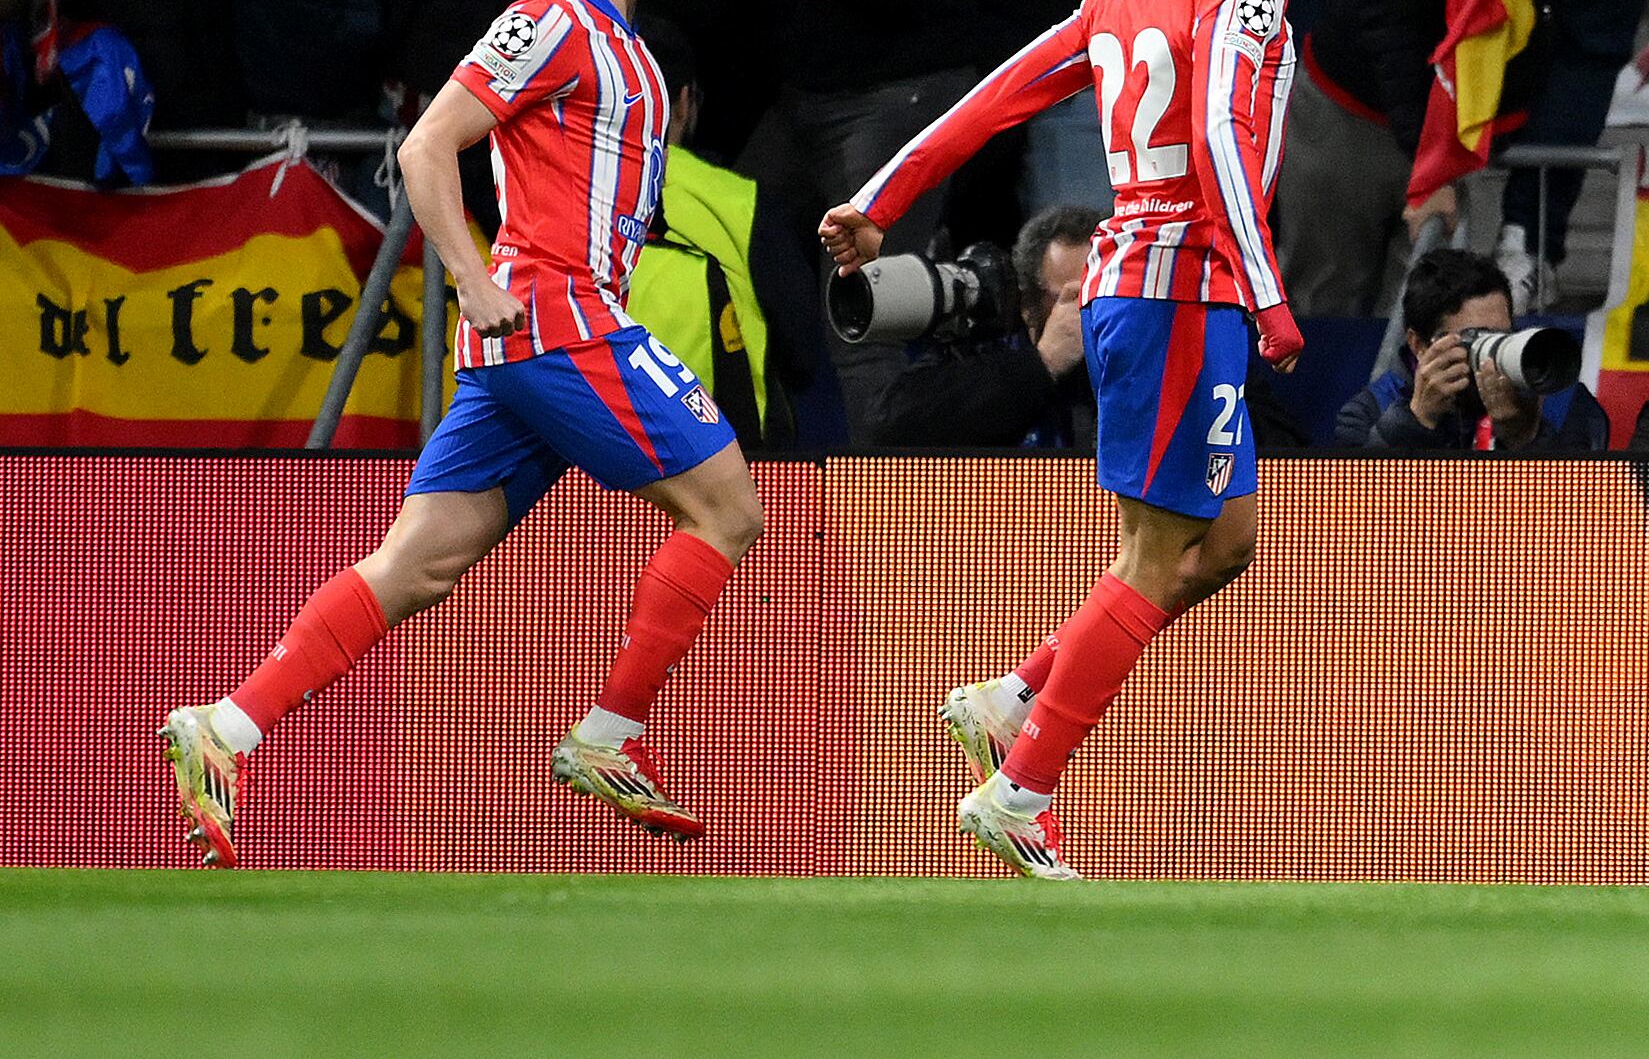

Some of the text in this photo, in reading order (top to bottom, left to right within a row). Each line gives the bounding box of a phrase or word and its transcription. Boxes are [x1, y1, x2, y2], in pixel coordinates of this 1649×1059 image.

[1088, 27, 1188, 186] 22
[1140, 197, 1195, 213] hildren
[36, 278, 458, 367] del fres
[627, 334, 696, 398] 19
[1206, 383, 1245, 446] 2
